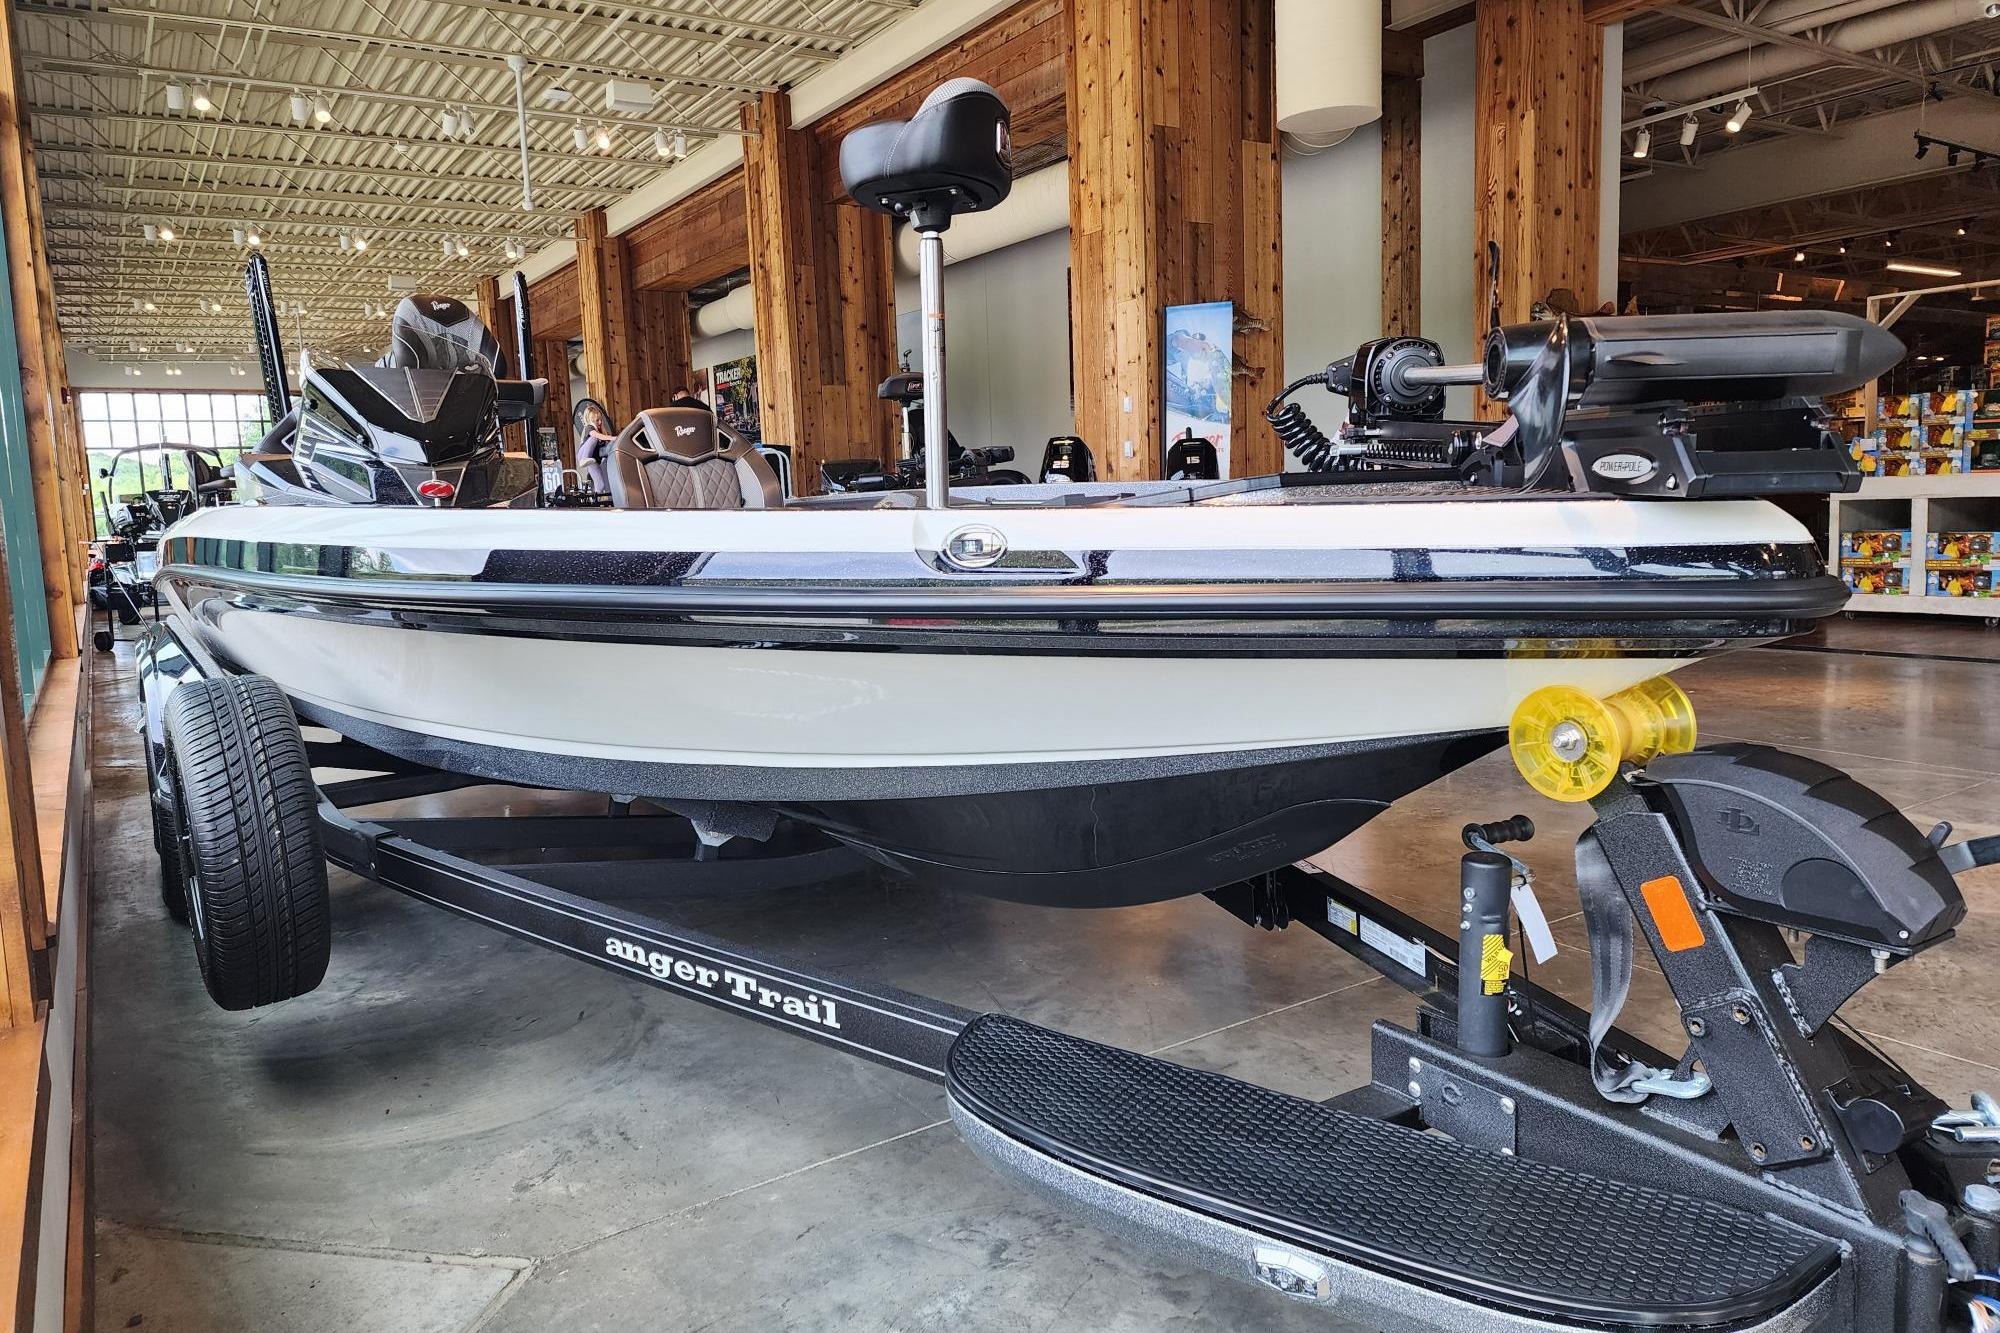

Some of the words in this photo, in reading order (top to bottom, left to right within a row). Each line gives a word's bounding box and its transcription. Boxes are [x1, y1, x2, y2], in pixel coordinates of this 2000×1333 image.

[1052, 460, 1070, 469] 25
[1186, 456, 1200, 464] 15
[1599, 461, 1642, 472] POWER-POLE
[605, 936, 720, 988] anger
[724, 969, 841, 1029] Trail
